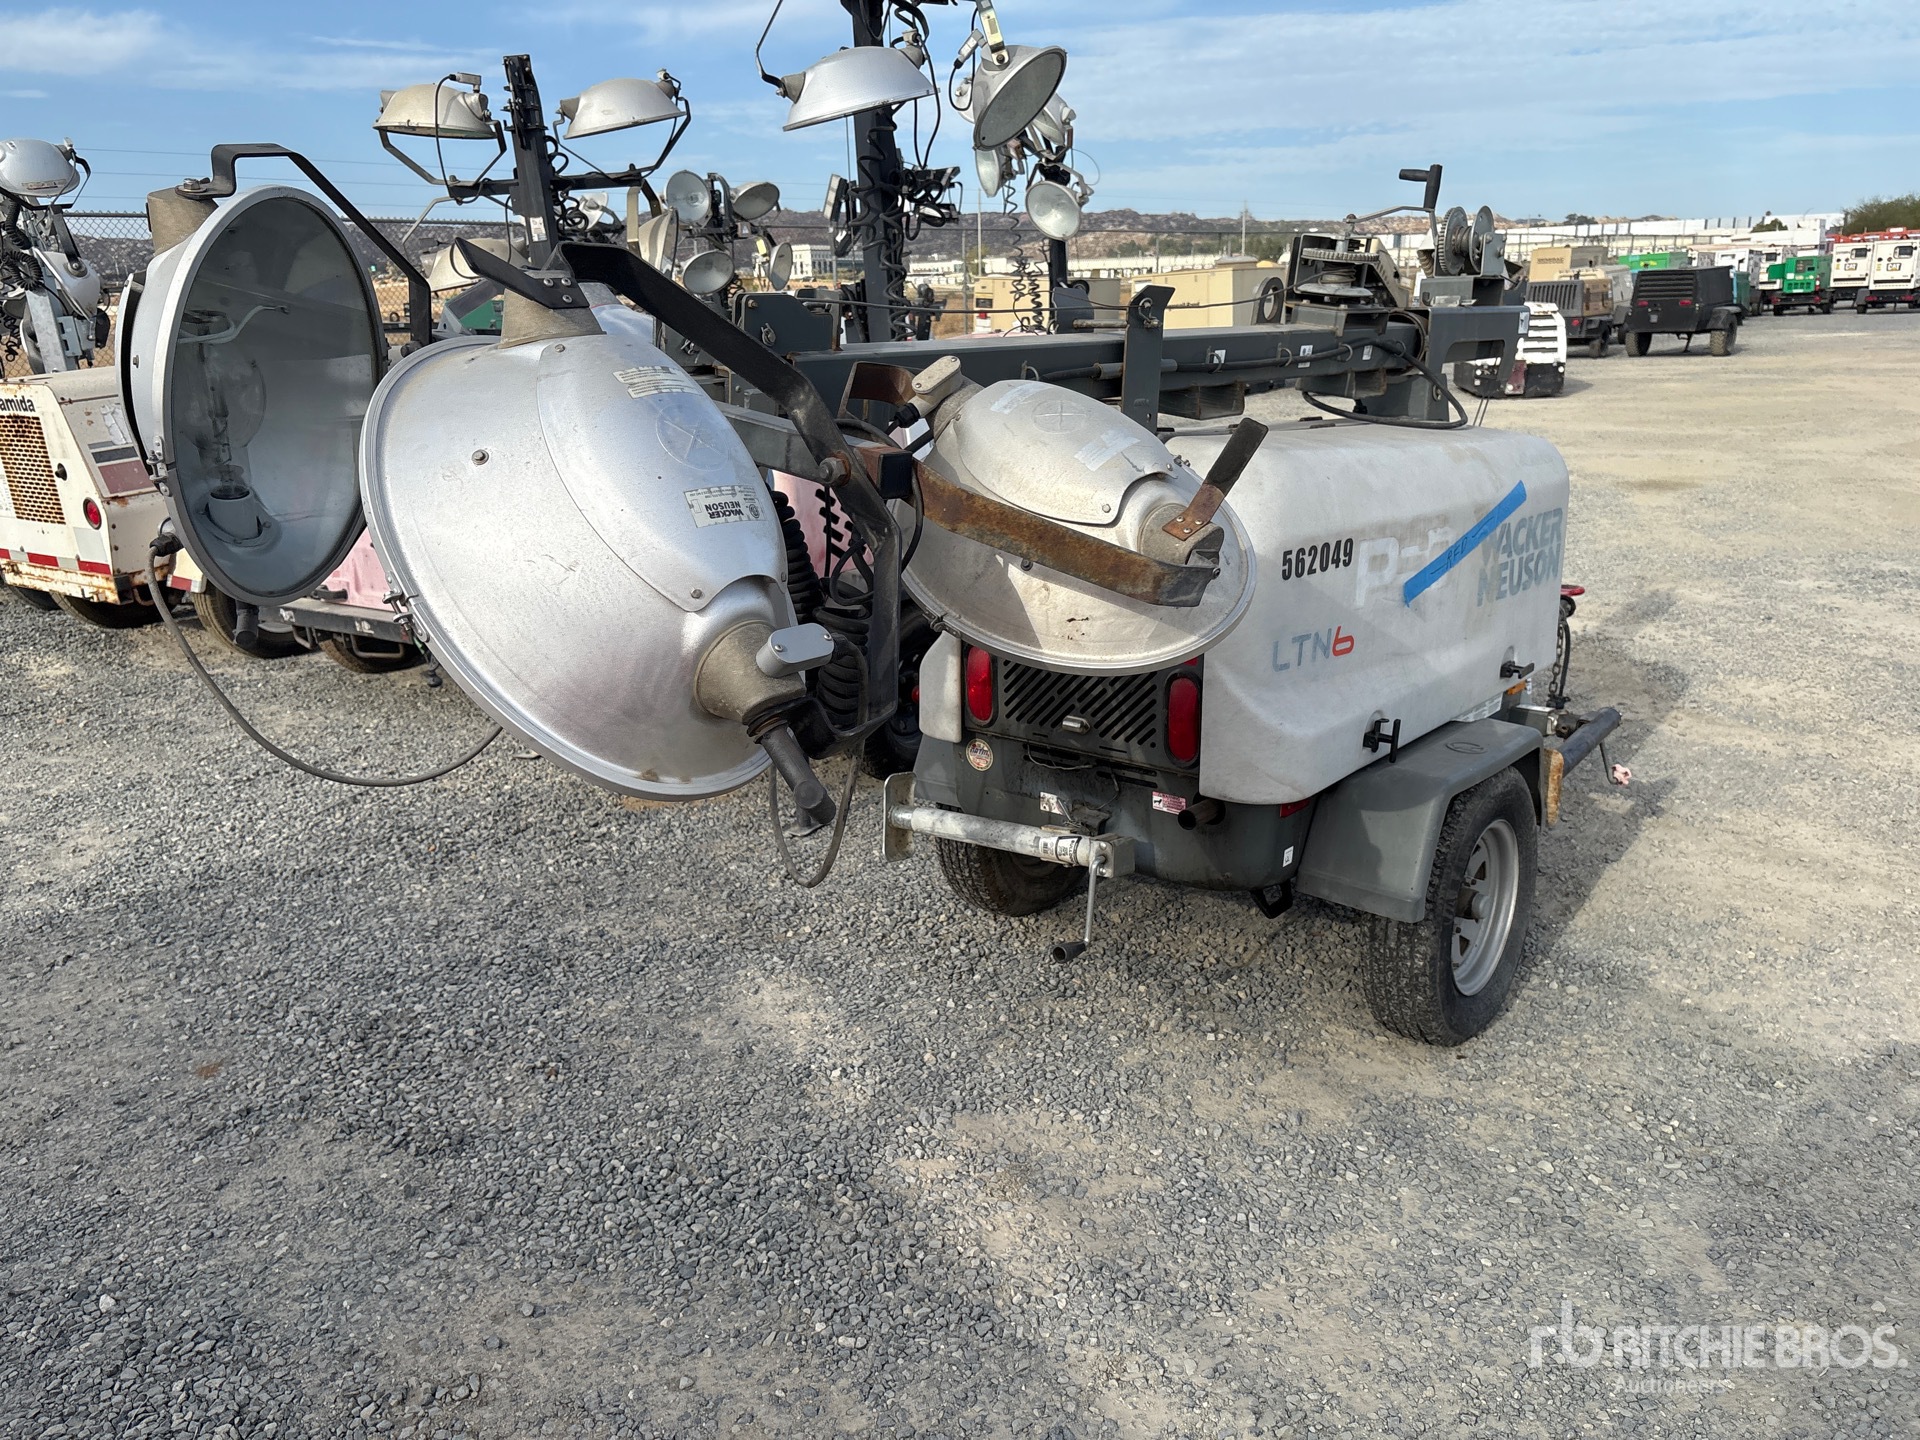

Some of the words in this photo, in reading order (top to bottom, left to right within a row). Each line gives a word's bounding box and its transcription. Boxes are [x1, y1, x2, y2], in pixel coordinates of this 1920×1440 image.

[1887, 263, 1900, 271] CAT
[704, 501, 742, 512] NEUSON
[708, 508, 744, 519] WACKER
[1281, 537, 1354, 580] 562049
[1476, 543, 1562, 608] NEUSON
[1272, 625, 1355, 672] LTN6
